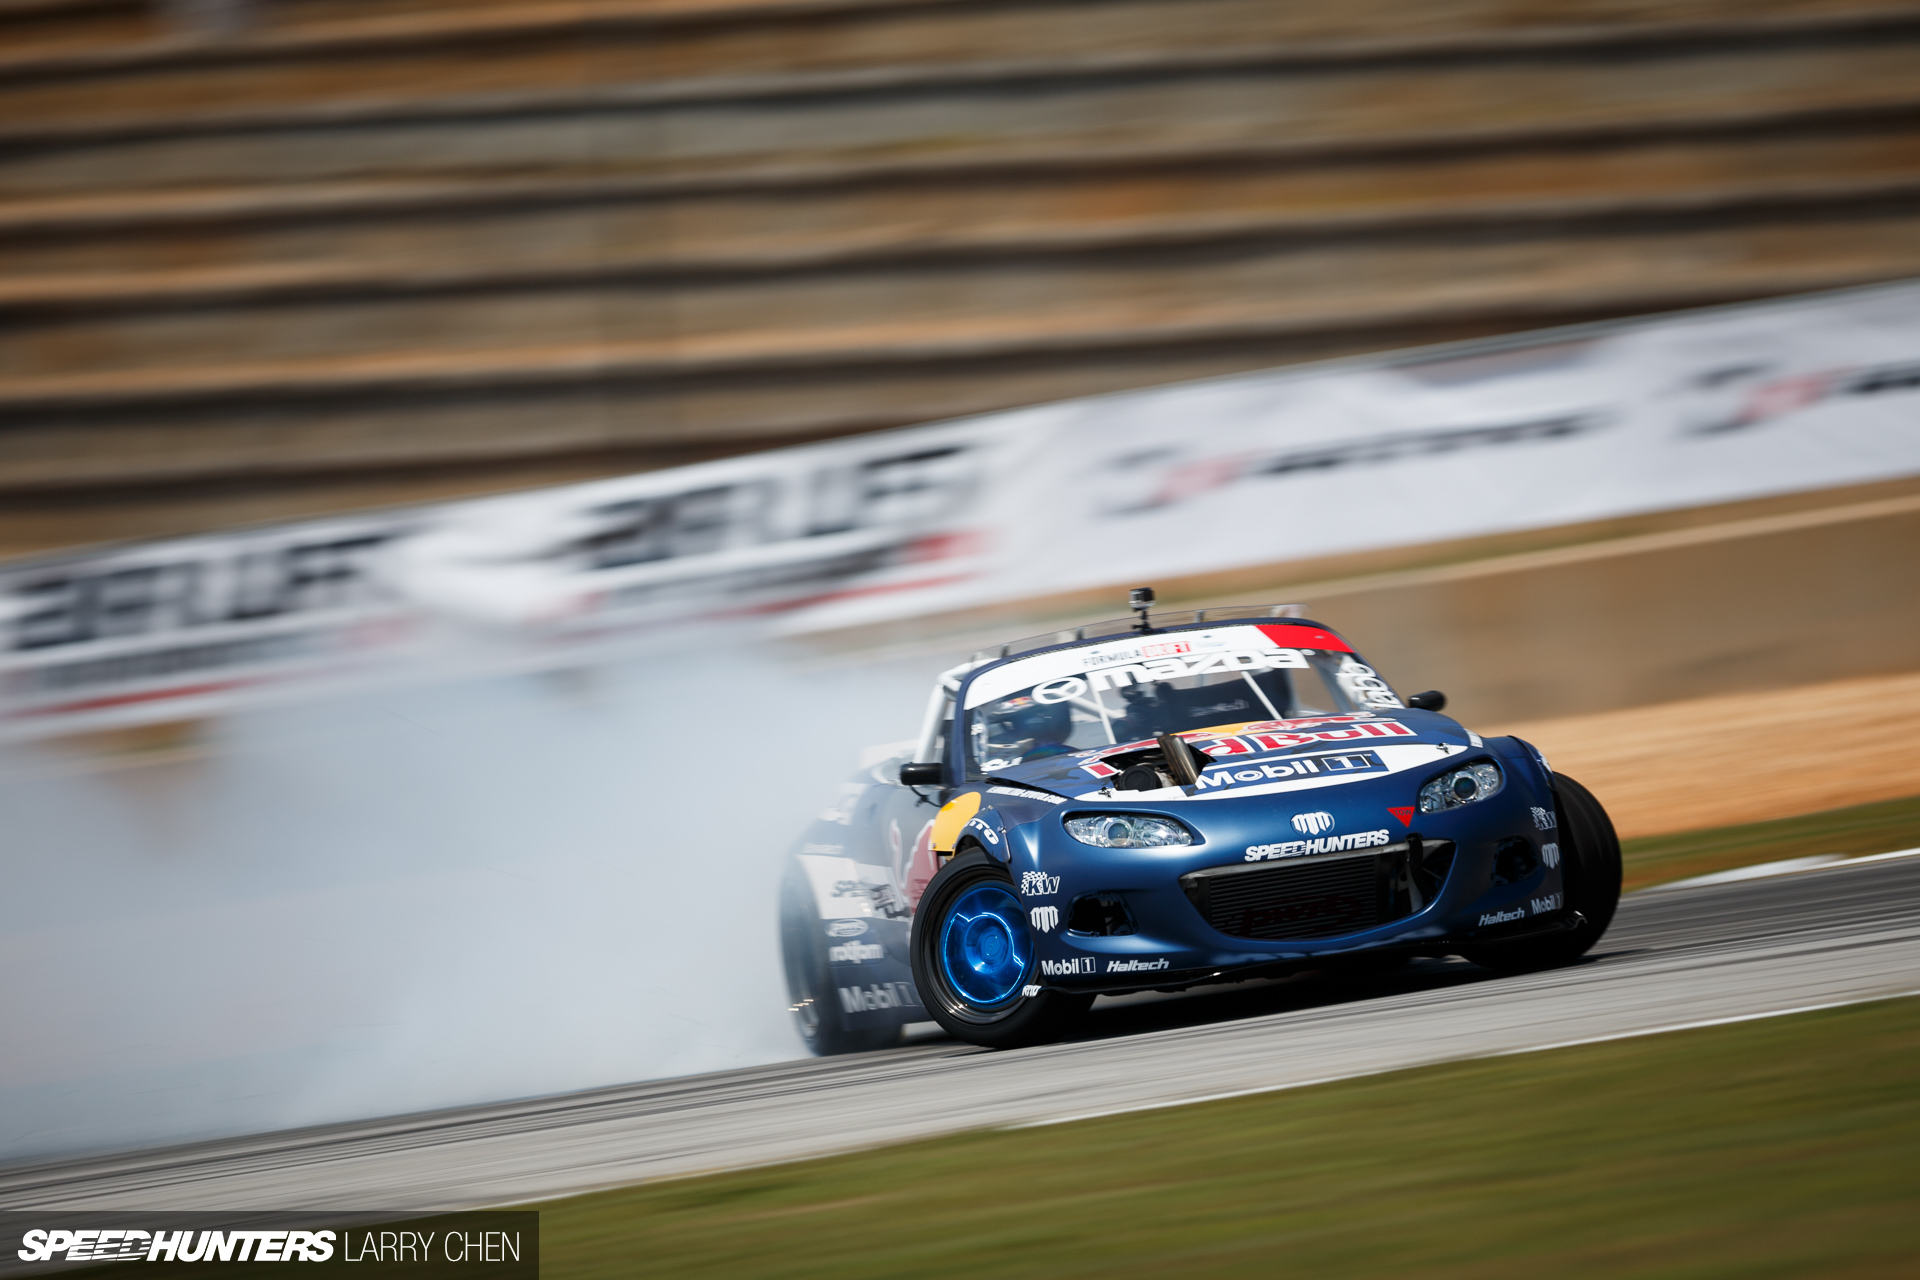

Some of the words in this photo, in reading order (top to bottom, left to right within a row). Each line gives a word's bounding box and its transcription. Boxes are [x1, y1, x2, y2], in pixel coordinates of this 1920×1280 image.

[1083, 648, 1142, 667] FORMULA
[1254, 722, 1418, 751] Bull
[1196, 759, 1320, 790] Mobil
[1393, 808, 1413, 817] TOW
[1244, 829, 1390, 862] SPEEDHUNTERS
[1026, 875, 1061, 896] KW
[1530, 895, 1556, 915] Mobil
[1478, 907, 1526, 927] Haltech
[1041, 958, 1080, 976] Mobil
[1106, 957, 1170, 973] Haltech
[838, 982, 901, 1014] Mobil
